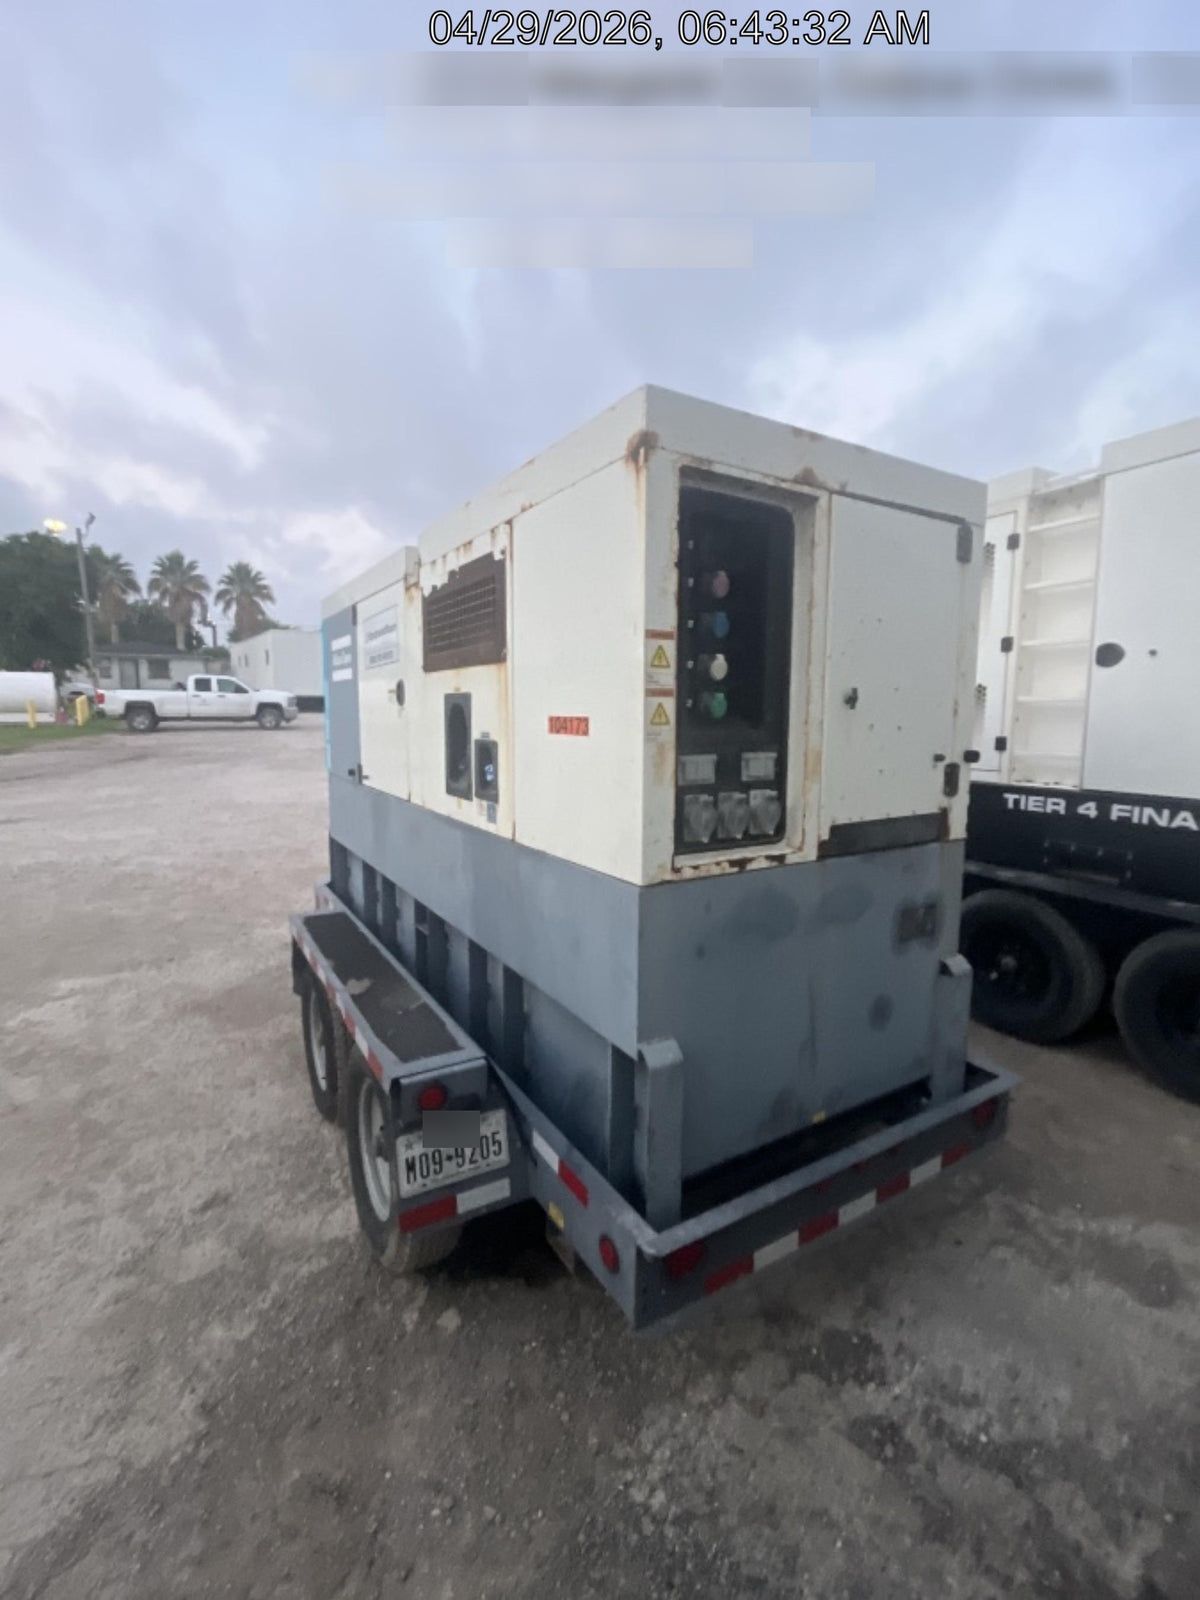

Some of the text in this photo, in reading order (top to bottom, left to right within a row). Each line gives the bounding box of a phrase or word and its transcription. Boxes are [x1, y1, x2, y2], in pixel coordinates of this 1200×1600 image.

[549, 716, 589, 736] 104173
[1003, 792, 1067, 816] TIER
[1077, 801, 1098, 819] 4
